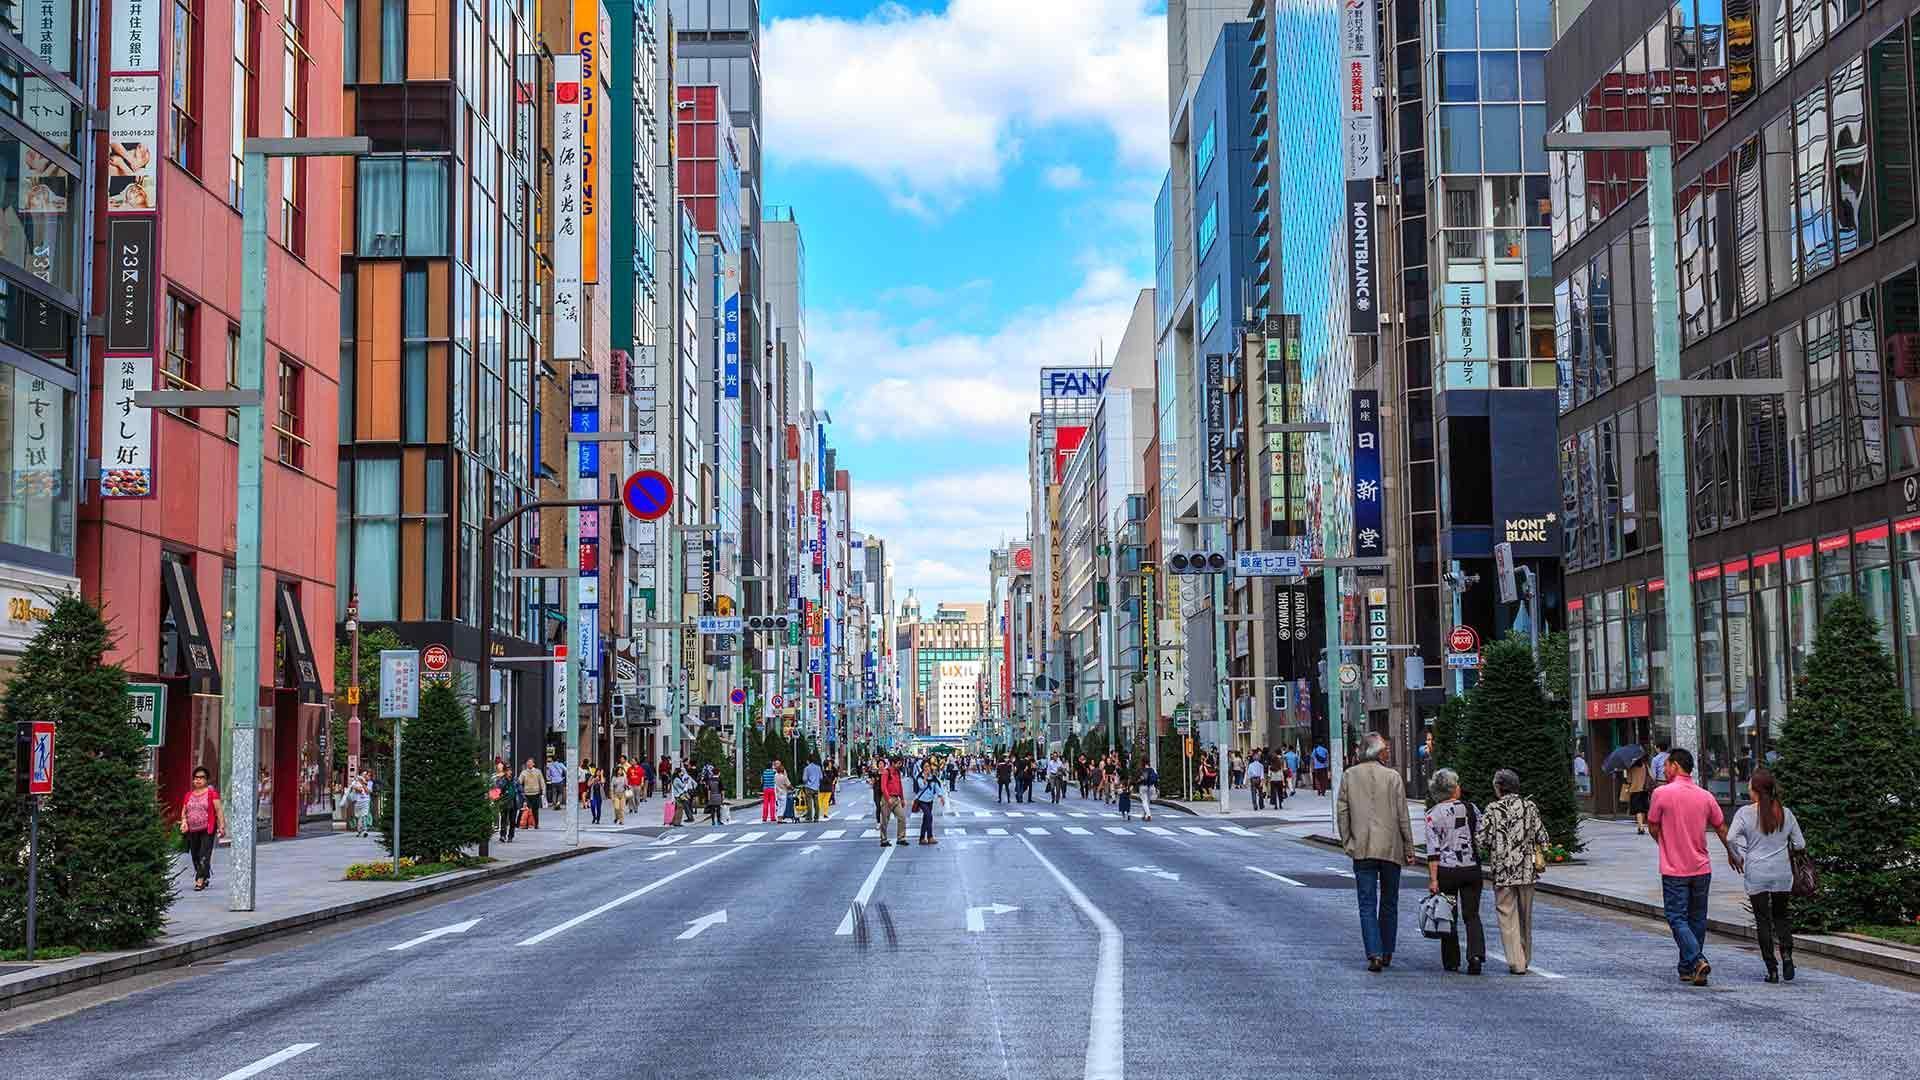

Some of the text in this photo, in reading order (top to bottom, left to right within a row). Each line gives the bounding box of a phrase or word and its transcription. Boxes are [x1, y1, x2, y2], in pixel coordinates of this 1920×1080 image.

[578, 31, 592, 77] CSS
[1352, 62, 1363, 112] 共立美容外科
[116, 105, 152, 117] レイア
[1354, 202, 1370, 298] MONTBLANC
[125, 285, 134, 324] GINZA
[725, 311, 737, 386] 名鉄観光
[1460, 287, 1473, 384] 三井不動産リアルティ
[116, 361, 138, 464] 築地すし好
[1356, 399, 1379, 548] 銀座 日新堂
[1505, 519, 1546, 531] MONT
[1506, 530, 1547, 542] BLANC
[1240, 556, 1297, 568] 銀座七丁目
[1278, 591, 1289, 629] YAMAHA
[1373, 609, 1386, 686] ROLEX
[942, 665, 974, 678] LIXIL
